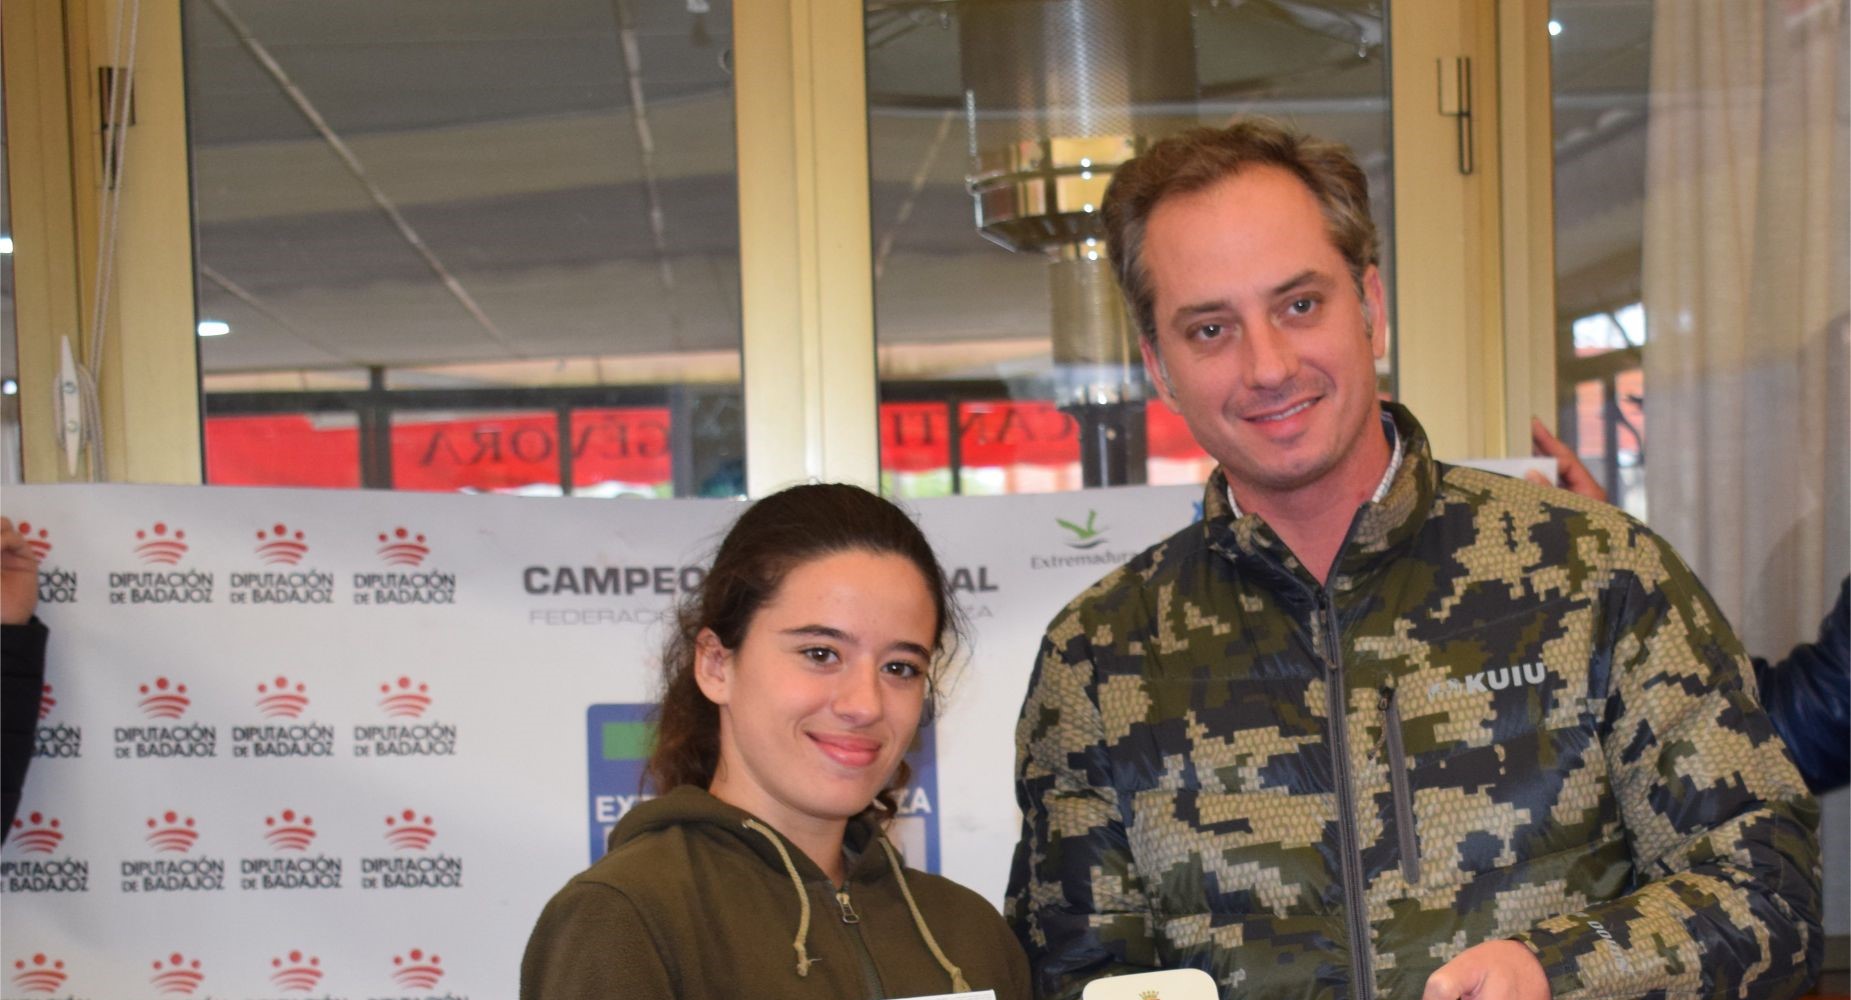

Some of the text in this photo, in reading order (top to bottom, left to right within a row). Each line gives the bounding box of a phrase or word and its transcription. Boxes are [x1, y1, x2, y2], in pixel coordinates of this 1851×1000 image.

[109, 570, 213, 590] DIPUTACIÓN
[230, 569, 334, 589] DIPUTACIÓN
[354, 570, 456, 590] DIPUTACIÓN
[109, 587, 213, 604] DE BADAJOZ
[230, 587, 334, 604] DE BADAJOZ
[354, 587, 456, 604] DE BADAJOZ
[1464, 661, 1546, 695] KUIU
[114, 723, 216, 743] DIPUTACIÓN
[232, 723, 334, 743] DIPUTACIÓN
[354, 722, 456, 742] DIPUTACIÓN
[114, 741, 216, 758] DE BADAJOZ
[232, 740, 334, 757] DE BADAJOZ
[354, 740, 456, 757] DE BADAJOZ
[121, 857, 224, 877] DIPUTACIÓN
[241, 855, 342, 875] DIPUTACIÓN
[361, 855, 462, 875] DIPUTACIÓN
[9, 876, 88, 892] BADAJOZ
[121, 875, 224, 892] DE BADAJOZ
[241, 873, 342, 890] DE BADAJOZ
[361, 871, 462, 888] DE BADAJOZ
